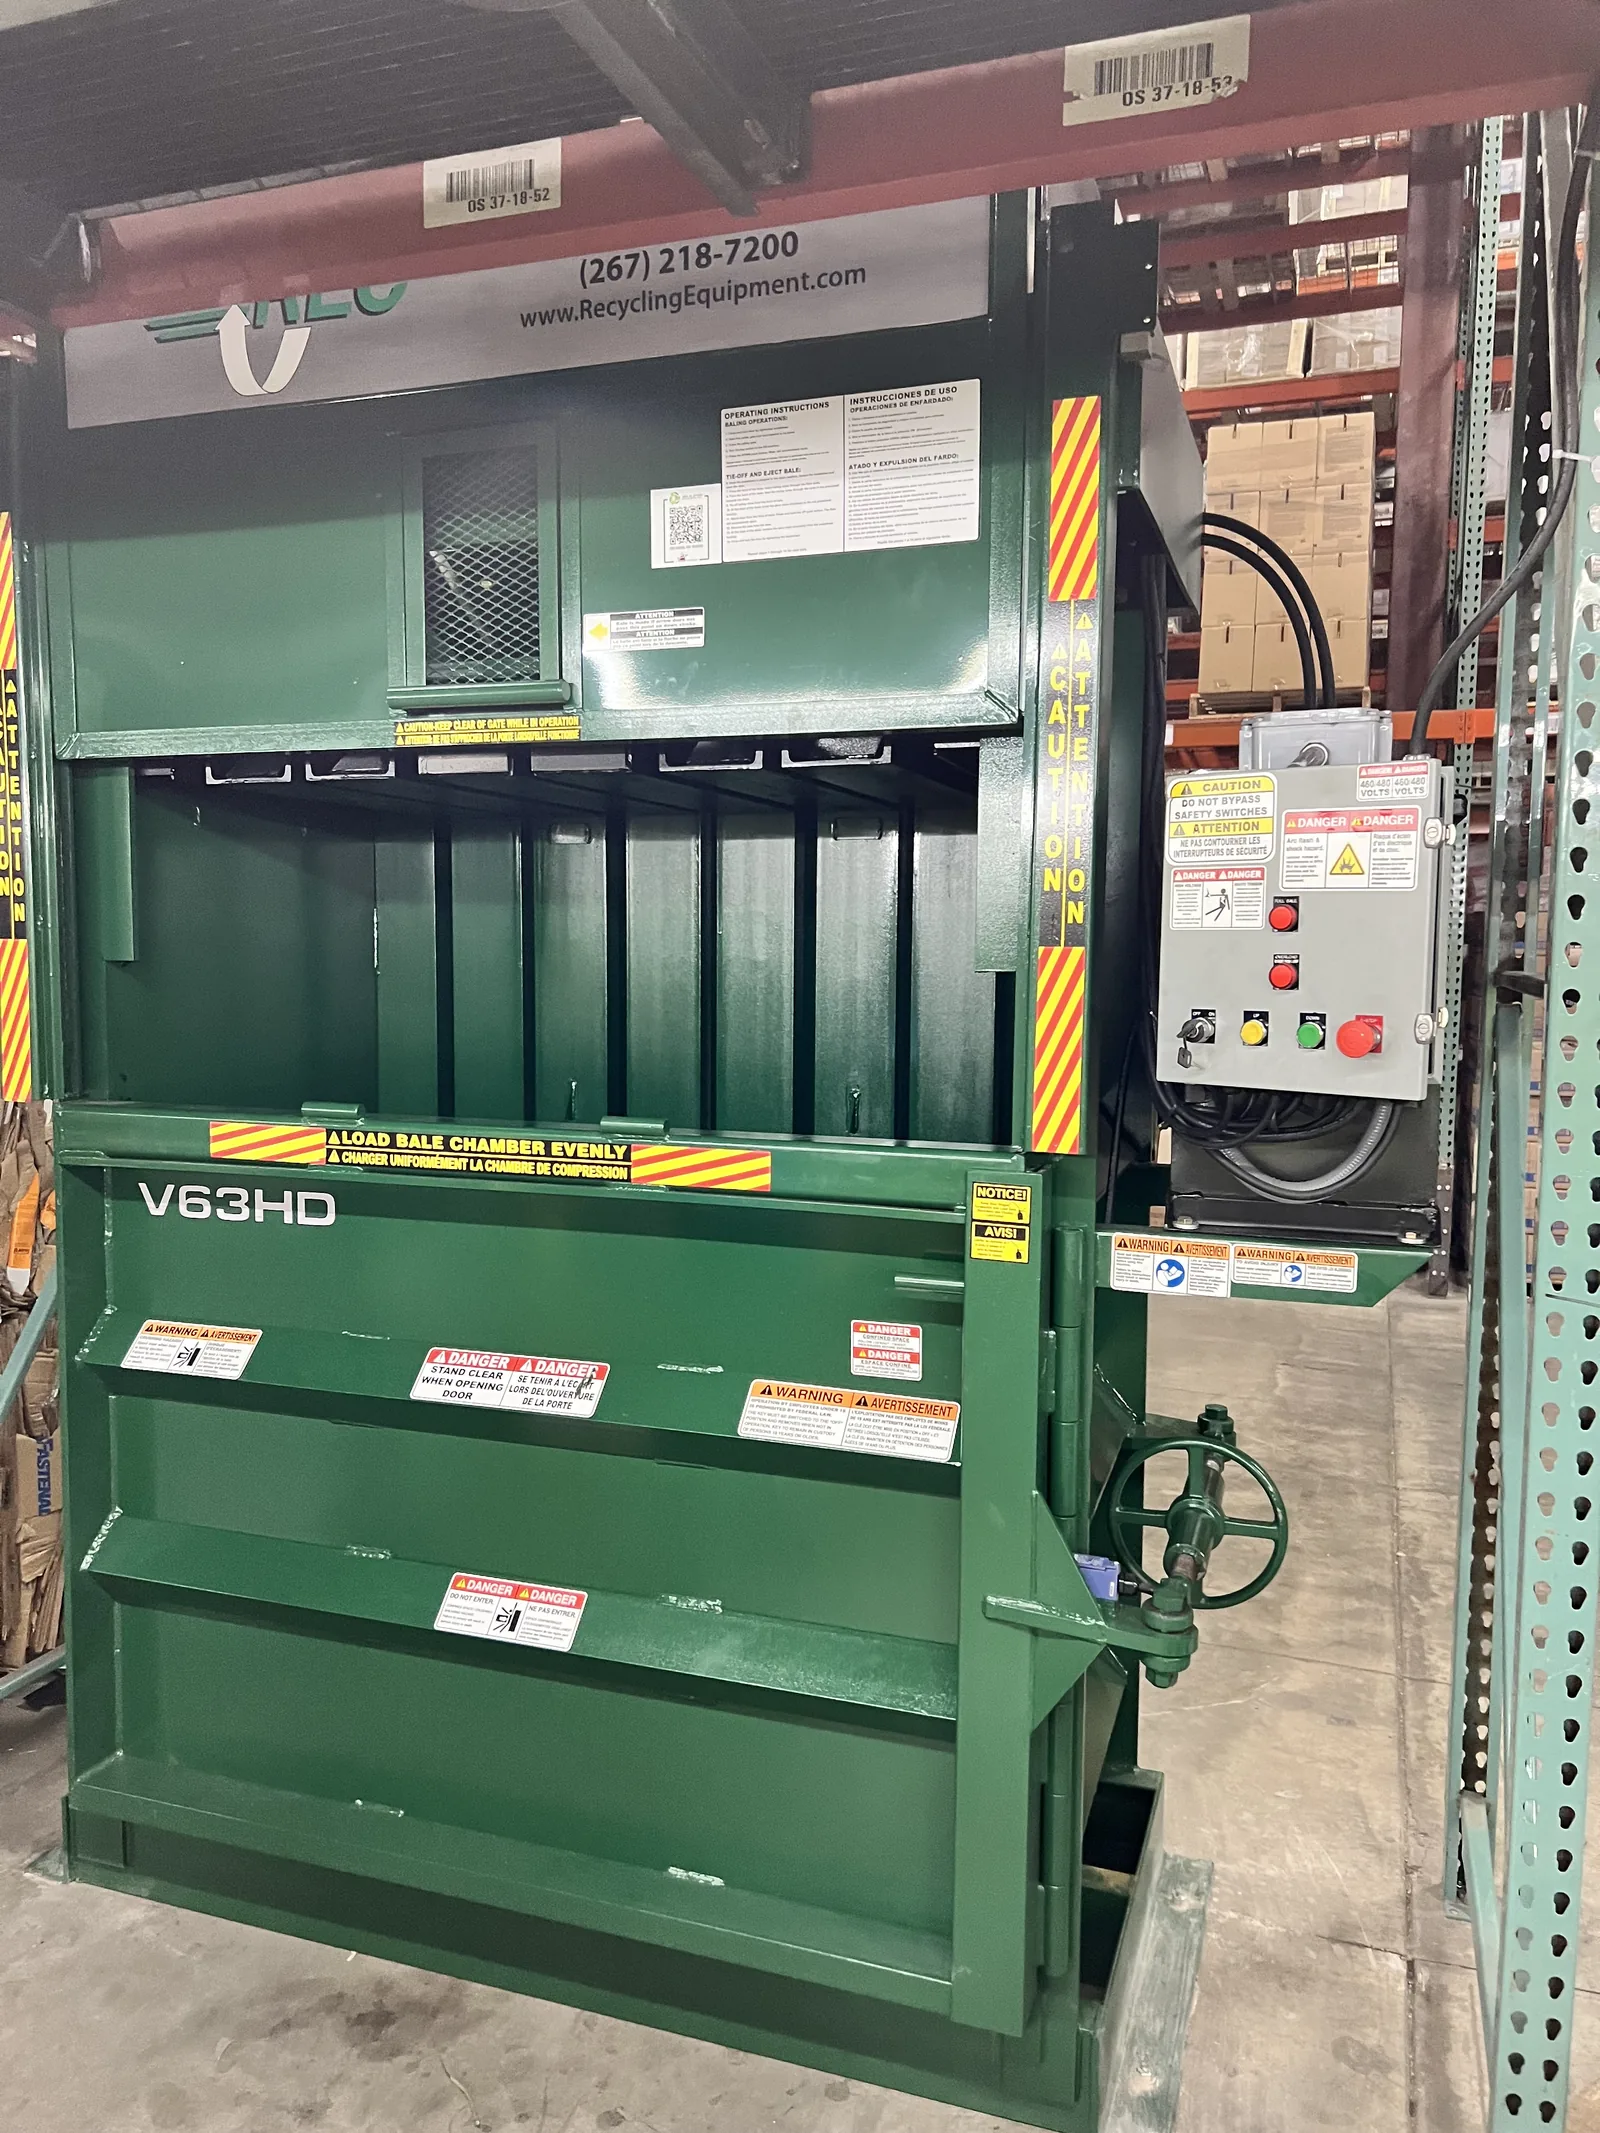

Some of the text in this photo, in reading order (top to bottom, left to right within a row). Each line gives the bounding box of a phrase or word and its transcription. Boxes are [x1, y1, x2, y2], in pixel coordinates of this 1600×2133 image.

[1123, 90, 1145, 106] OS
[468, 188, 550, 212] OS 37-18-52
[580, 231, 798, 289] (267) 218-7200
[520, 266, 866, 328] www.RecyclingEquipment.com
[850, 391, 921, 405] INSTRUCCIONES
[939, 386, 957, 394] USO
[725, 402, 829, 419] OPERATING INSTRUCTIONS
[850, 402, 898, 413] OPERACIONES
[910, 396, 953, 406] ENFARDADO:
[749, 416, 788, 425] OPERATIONS:
[880, 457, 917, 466] EXPULSION
[934, 453, 959, 461] FARDO:
[635, 611, 674, 620] ATTENTION
[453, 719, 476, 730] CLEAR
[477, 719, 487, 729] OF
[487, 719, 505, 729] GATE
[506, 718, 529, 728] WHILE
[539, 716, 579, 727] OPERATION
[1043, 665, 1067, 892] CAUTION
[1066, 637, 1091, 925] ATTENTION
[1203, 780, 1261, 792] CAUTION
[1395, 787, 1424, 795] VOLTS
[1198, 798, 1218, 806] NOT
[1222, 795, 1261, 805] BYPASS
[6, 699, 26, 922] ATTENTION
[1175, 807, 1267, 819] SAFETY SWITCHES
[1298, 817, 1346, 828] DANGER
[1363, 815, 1414, 826] DANGER
[1193, 822, 1260, 834] ATTENTION
[1190, 839, 1202, 847] PAS
[1204, 837, 1247, 846] CONTOURNER
[1174, 848, 1224, 858] INTERRUPTEURS
[1182, 872, 1216, 880] DANGER
[1227, 870, 1262, 878] DANGER
[342, 1131, 628, 1160] LOAD BALE CHAMBER EVENLY
[342, 1152, 388, 1166] CHARGER
[470, 1158, 483, 1172] LA
[485, 1160, 535, 1174] CHAMBRE
[537, 1162, 551, 1175] DE
[552, 1163, 628, 1180] COMPRESSION
[977, 1187, 1026, 1200] NOTICE!
[138, 1182, 336, 1226] V63HD
[984, 1226, 1017, 1238] AVIS!
[1129, 1238, 1169, 1252] WARNING
[1186, 1244, 1227, 1257] AVERTISSEMENT
[1247, 1249, 1291, 1261] WARNING
[1306, 1254, 1352, 1265] AVERTISSEMENT
[154, 1325, 199, 1337] WARNING
[210, 1330, 257, 1342] AVERTISSEMENT
[868, 1325, 911, 1336] DANGER
[449, 1352, 510, 1369] DANGER
[868, 1350, 911, 1361] DANGER
[430, 1365, 503, 1380] STAND CLEAR
[535, 1360, 599, 1378] DANGER
[421, 1376, 504, 1392] WHEN OPENING
[517, 1375, 529, 1383] SE
[530, 1377, 553, 1385] TENIR
[442, 1390, 473, 1401] DOOR
[509, 1386, 529, 1395] LORS
[776, 1386, 844, 1404] WARNING
[522, 1398, 573, 1410] DE LA PORTE
[871, 1398, 953, 1417] AVERTISSEMENT
[467, 1579, 513, 1596] DANGER
[530, 1589, 578, 1606] DANGER
